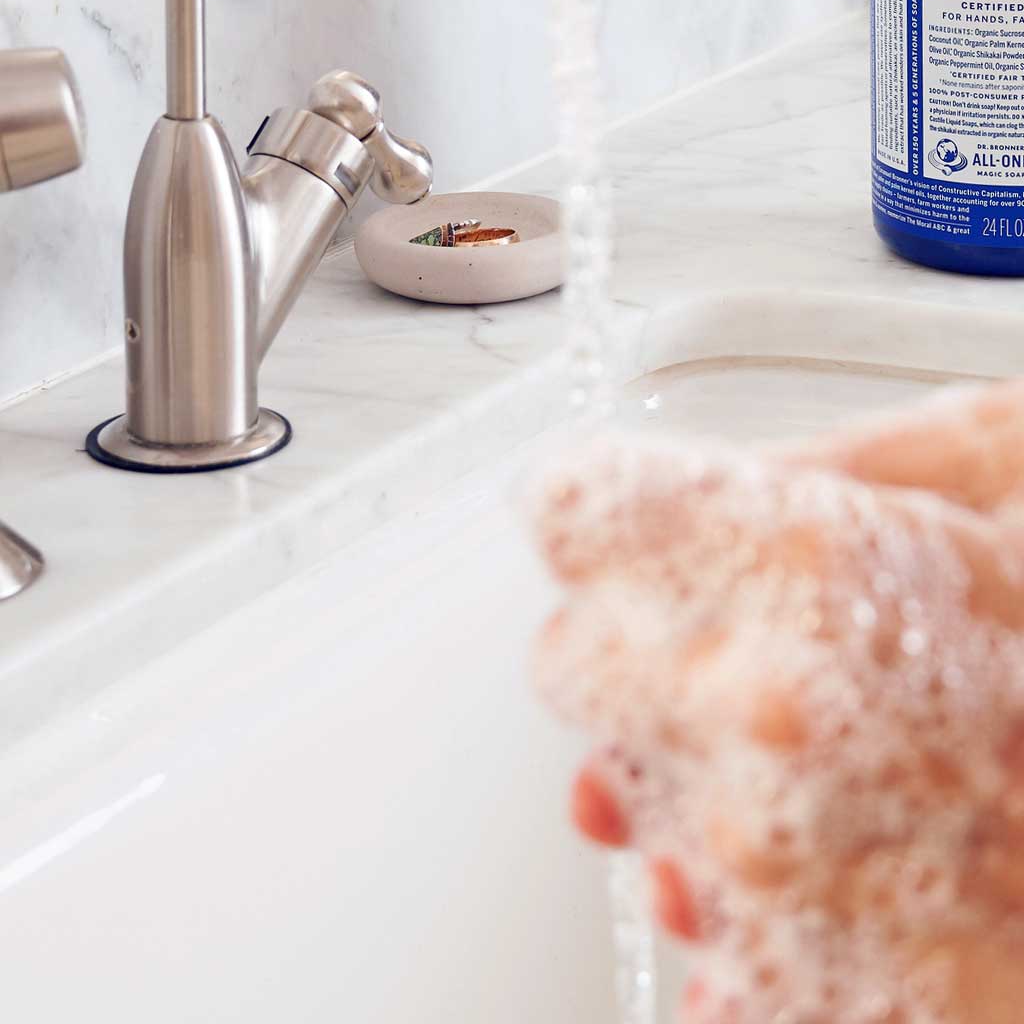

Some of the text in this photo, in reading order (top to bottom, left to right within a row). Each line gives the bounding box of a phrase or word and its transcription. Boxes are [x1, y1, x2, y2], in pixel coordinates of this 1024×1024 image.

[961, 1, 1024, 12] CERTIFIED
[912, 16, 917, 28] OF
[942, 12, 962, 21] FOR
[966, 14, 1008, 25] HANDS,
[929, 25, 973, 35] INGREDIENTS:
[975, 29, 998, 37] Organic
[929, 35, 951, 44] Coconut
[964, 39, 988, 48] Organic
[929, 46, 941, 54] Olive
[953, 49, 975, 58] Organic
[977, 51, 1001, 59] Shikakai
[929, 57, 948, 66] Organic
[950, 59, 983, 69] Peppermint
[996, 63, 1018, 71] Organic
[950, 90, 1018, 100] POST-CONSUMER
[929, 98, 951, 106] CAUTION!
[953, 100, 966, 108] Don't
[938, 185, 979, 196] Constructive
[981, 190, 1020, 198] Capitalism,
[927, 192, 951, 202] together
[953, 196, 988, 207] accounting
[932, 203, 955, 212] workers
[932, 211, 948, 219] harm
[982, 217, 997, 236] 24
[1000, 218, 1012, 237] FL
